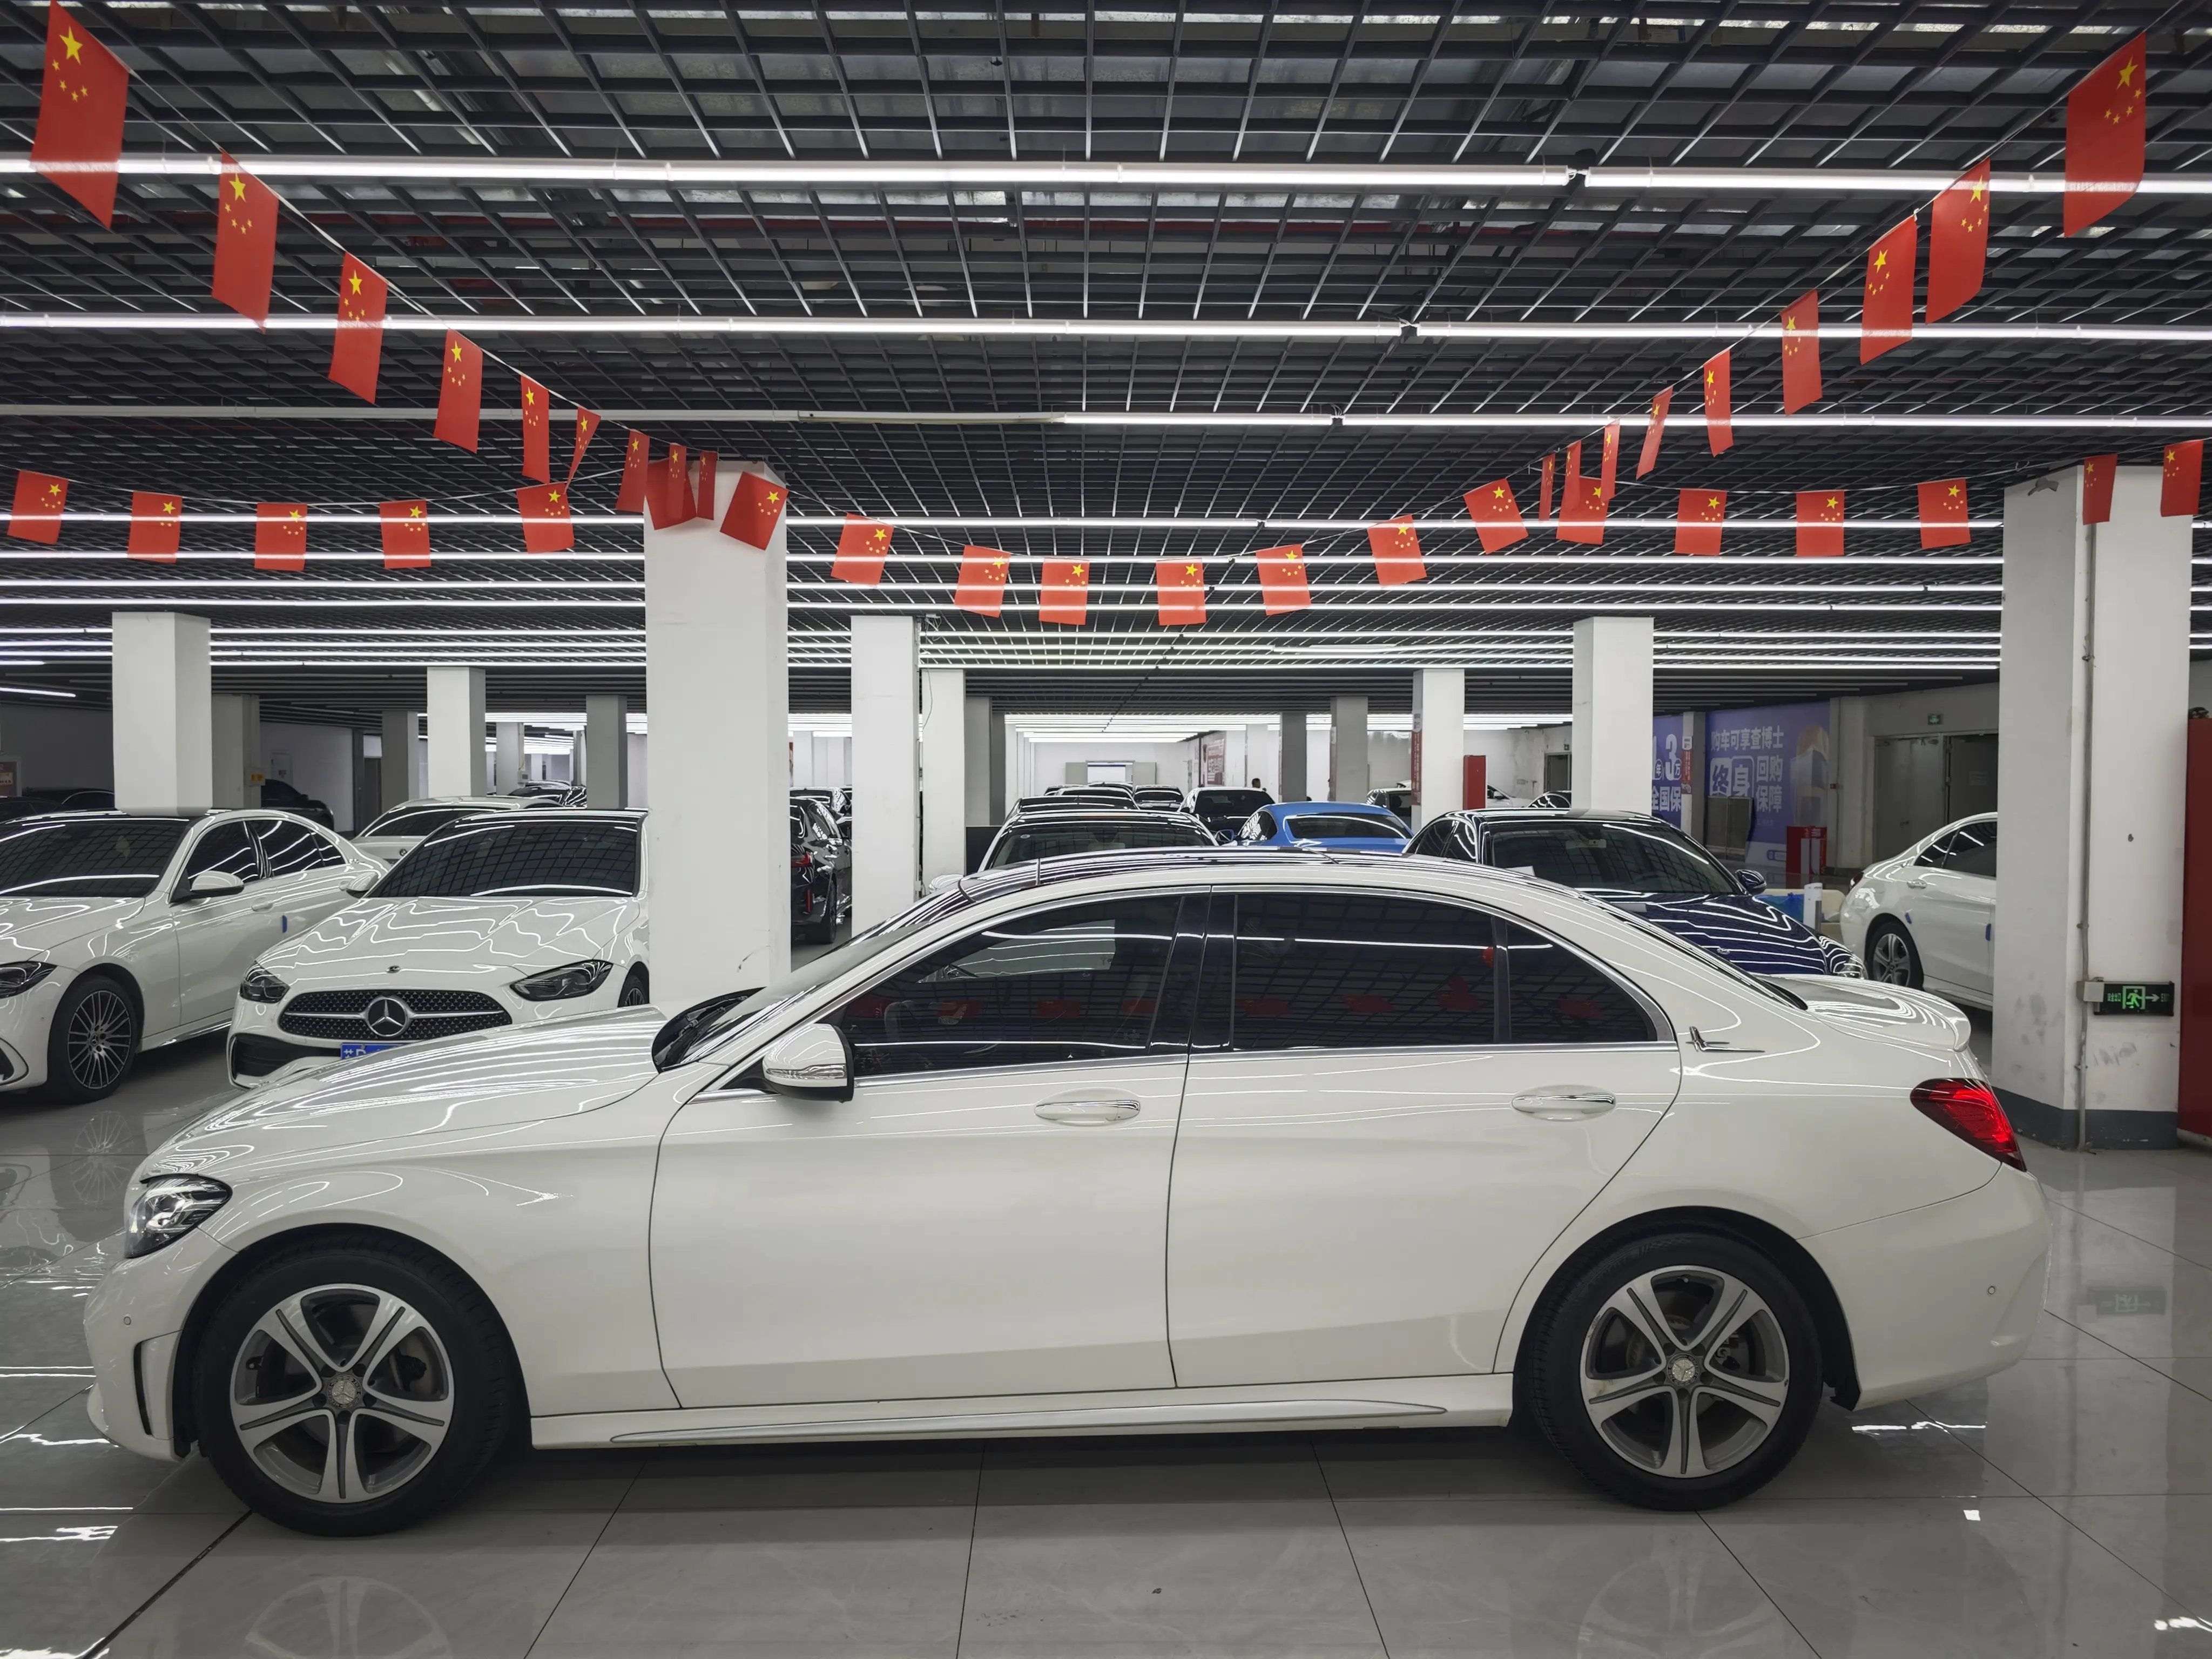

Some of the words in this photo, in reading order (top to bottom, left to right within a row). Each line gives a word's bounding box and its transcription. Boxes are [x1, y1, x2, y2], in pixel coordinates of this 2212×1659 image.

[1711, 725, 1784, 752] 购车可享查博士
[1712, 764, 1750, 797] 终身
[1757, 755, 1783, 782] 回购
[1756, 785, 1782, 813] 保障
